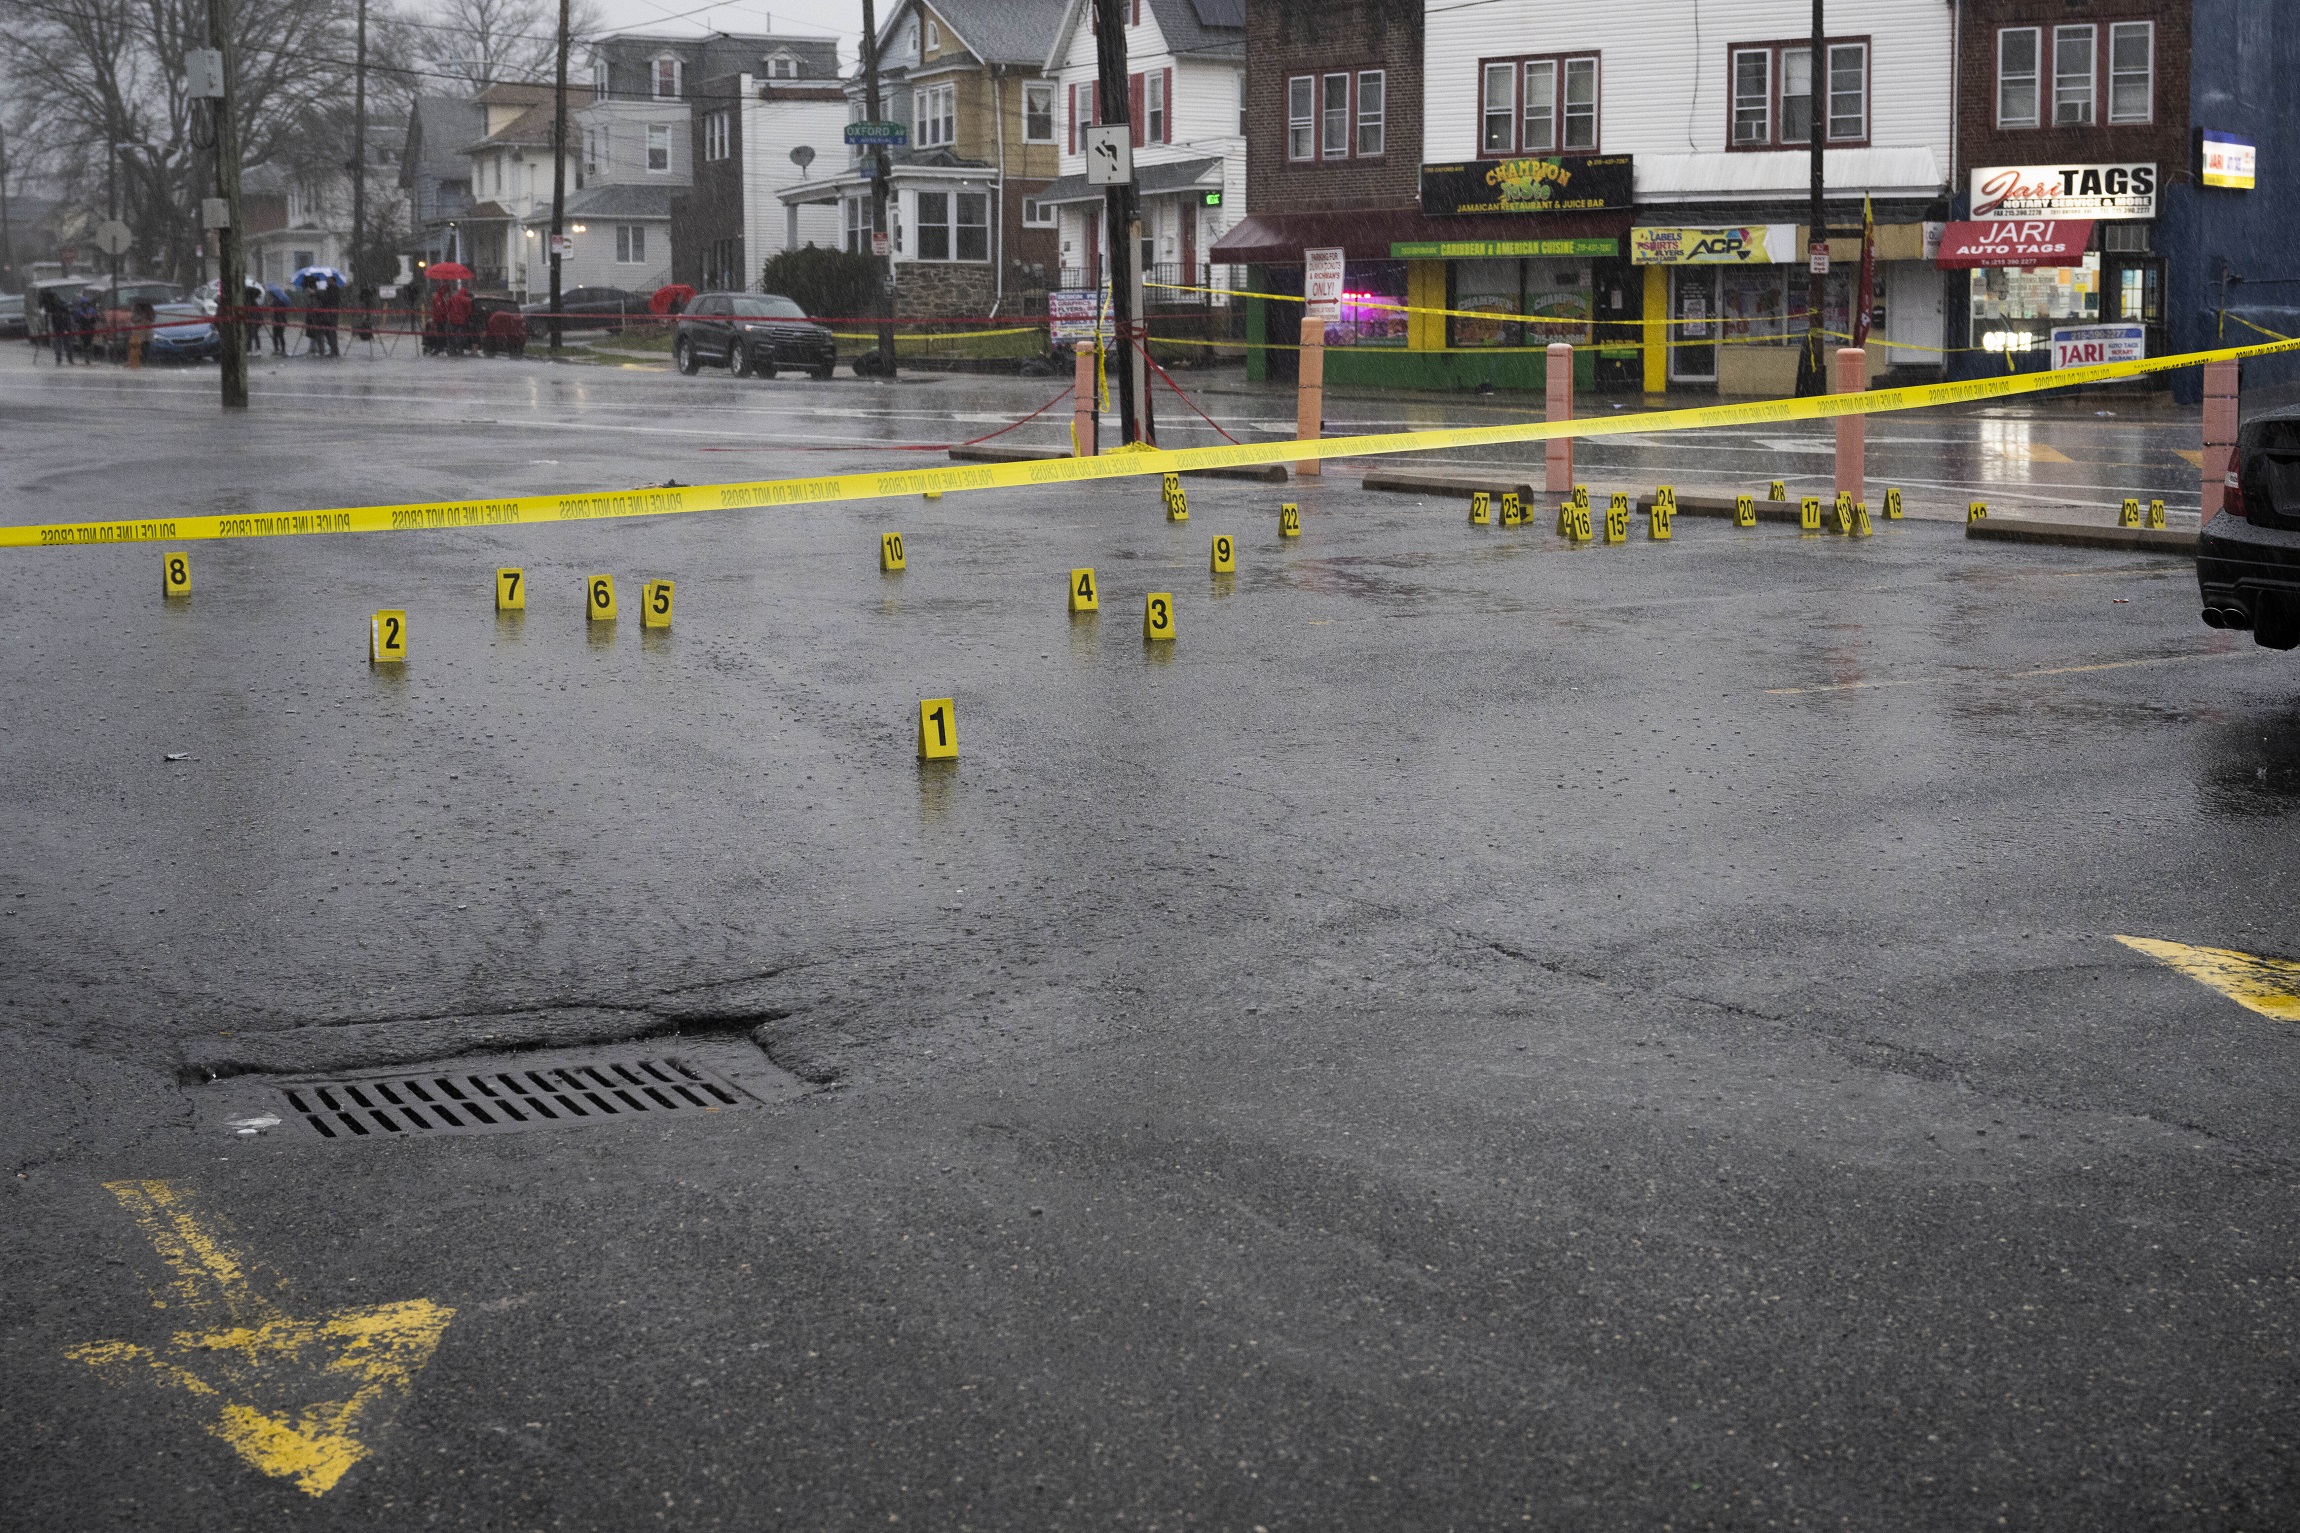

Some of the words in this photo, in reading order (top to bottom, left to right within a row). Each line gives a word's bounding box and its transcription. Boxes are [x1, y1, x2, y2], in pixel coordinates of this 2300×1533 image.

[846, 126, 890, 137] OXFORD
[1485, 159, 1572, 188] CHAMPION
[1972, 170, 2064, 217] Jari
[2058, 167, 2154, 196] TAGS
[2003, 199, 2050, 209] NOTARY
[2051, 198, 2101, 208] SERVICE
[2103, 198, 2114, 207] &
[2115, 196, 2151, 206] MORE
[1457, 204, 1500, 213] JAMAICAN
[1500, 201, 1553, 212] RESTAURANT
[1554, 201, 1561, 209] &
[1562, 200, 1585, 209] JUICE
[1587, 199, 1605, 208] BAR
[1650, 232, 1682, 241] LABELS
[1979, 221, 2056, 244] JARI
[1440, 243, 1485, 256] CARIBBEAN
[1496, 242, 1538, 255] AMERICAN
[1541, 241, 1574, 254] CUISINE
[1685, 239, 1743, 261] ACP
[1956, 245, 2010, 255] AUTO
[2013, 243, 2066, 253] TAGS
[1312, 282, 1335, 297] ONLY!
[2058, 343, 2104, 368] JARI
[1172, 493, 1187, 514] 33
[1576, 488, 1589, 508] 26
[1659, 488, 1674, 509] 24
[1774, 485, 1786, 501] 28
[1890, 492, 1902, 514] 19
[1474, 496, 1488, 518] 27
[1504, 497, 1519, 519] 25
[1739, 498, 1754, 521] 20
[1804, 501, 1819, 523] 17
[1839, 502, 1850, 525] 13
[1859, 506, 1870, 529] 11
[2126, 502, 2139, 522] 29
[2153, 504, 2165, 524] 30
[1284, 508, 1299, 530] 22
[1575, 512, 1590, 535] 16
[1609, 513, 1625, 536] 15
[1653, 509, 1669, 532] 14
[886, 536, 903, 562] 10
[1217, 537, 1231, 563] 9
[169, 558, 187, 585] 8
[503, 572, 521, 601] 7
[593, 580, 611, 609] 6
[1077, 573, 1094, 602] 4
[652, 584, 671, 615] 5
[1151, 598, 1168, 630] 3
[385, 617, 400, 649] 2
[929, 706, 947, 747] 1
